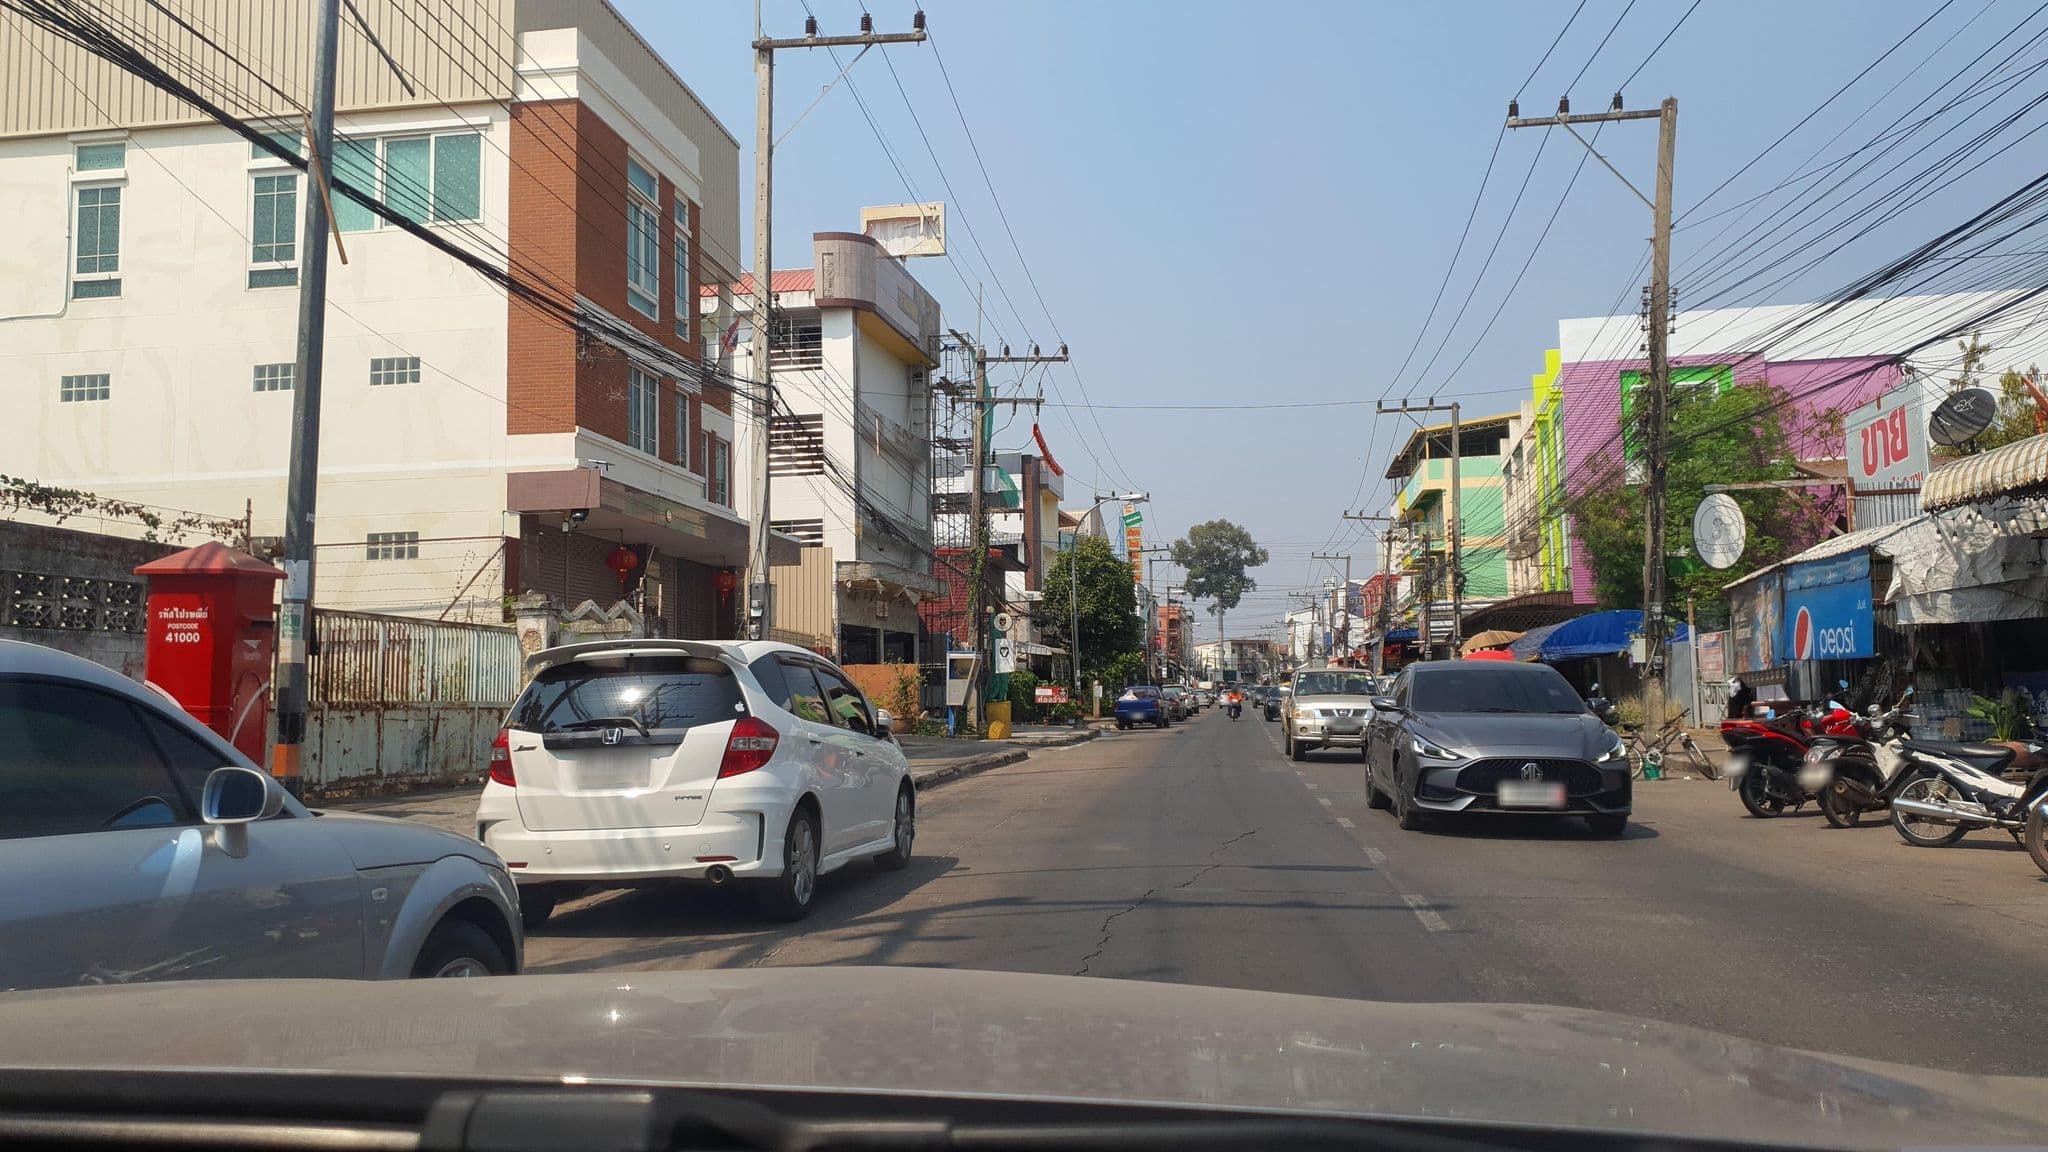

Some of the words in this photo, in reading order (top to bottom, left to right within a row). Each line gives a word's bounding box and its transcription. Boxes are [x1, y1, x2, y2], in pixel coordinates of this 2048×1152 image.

[1861, 404, 1908, 476] ขาย
[158, 607, 208, 618] รหัสไปรษณีย์
[165, 632, 200, 642] 41000
[1820, 619, 1854, 659] pepsi
